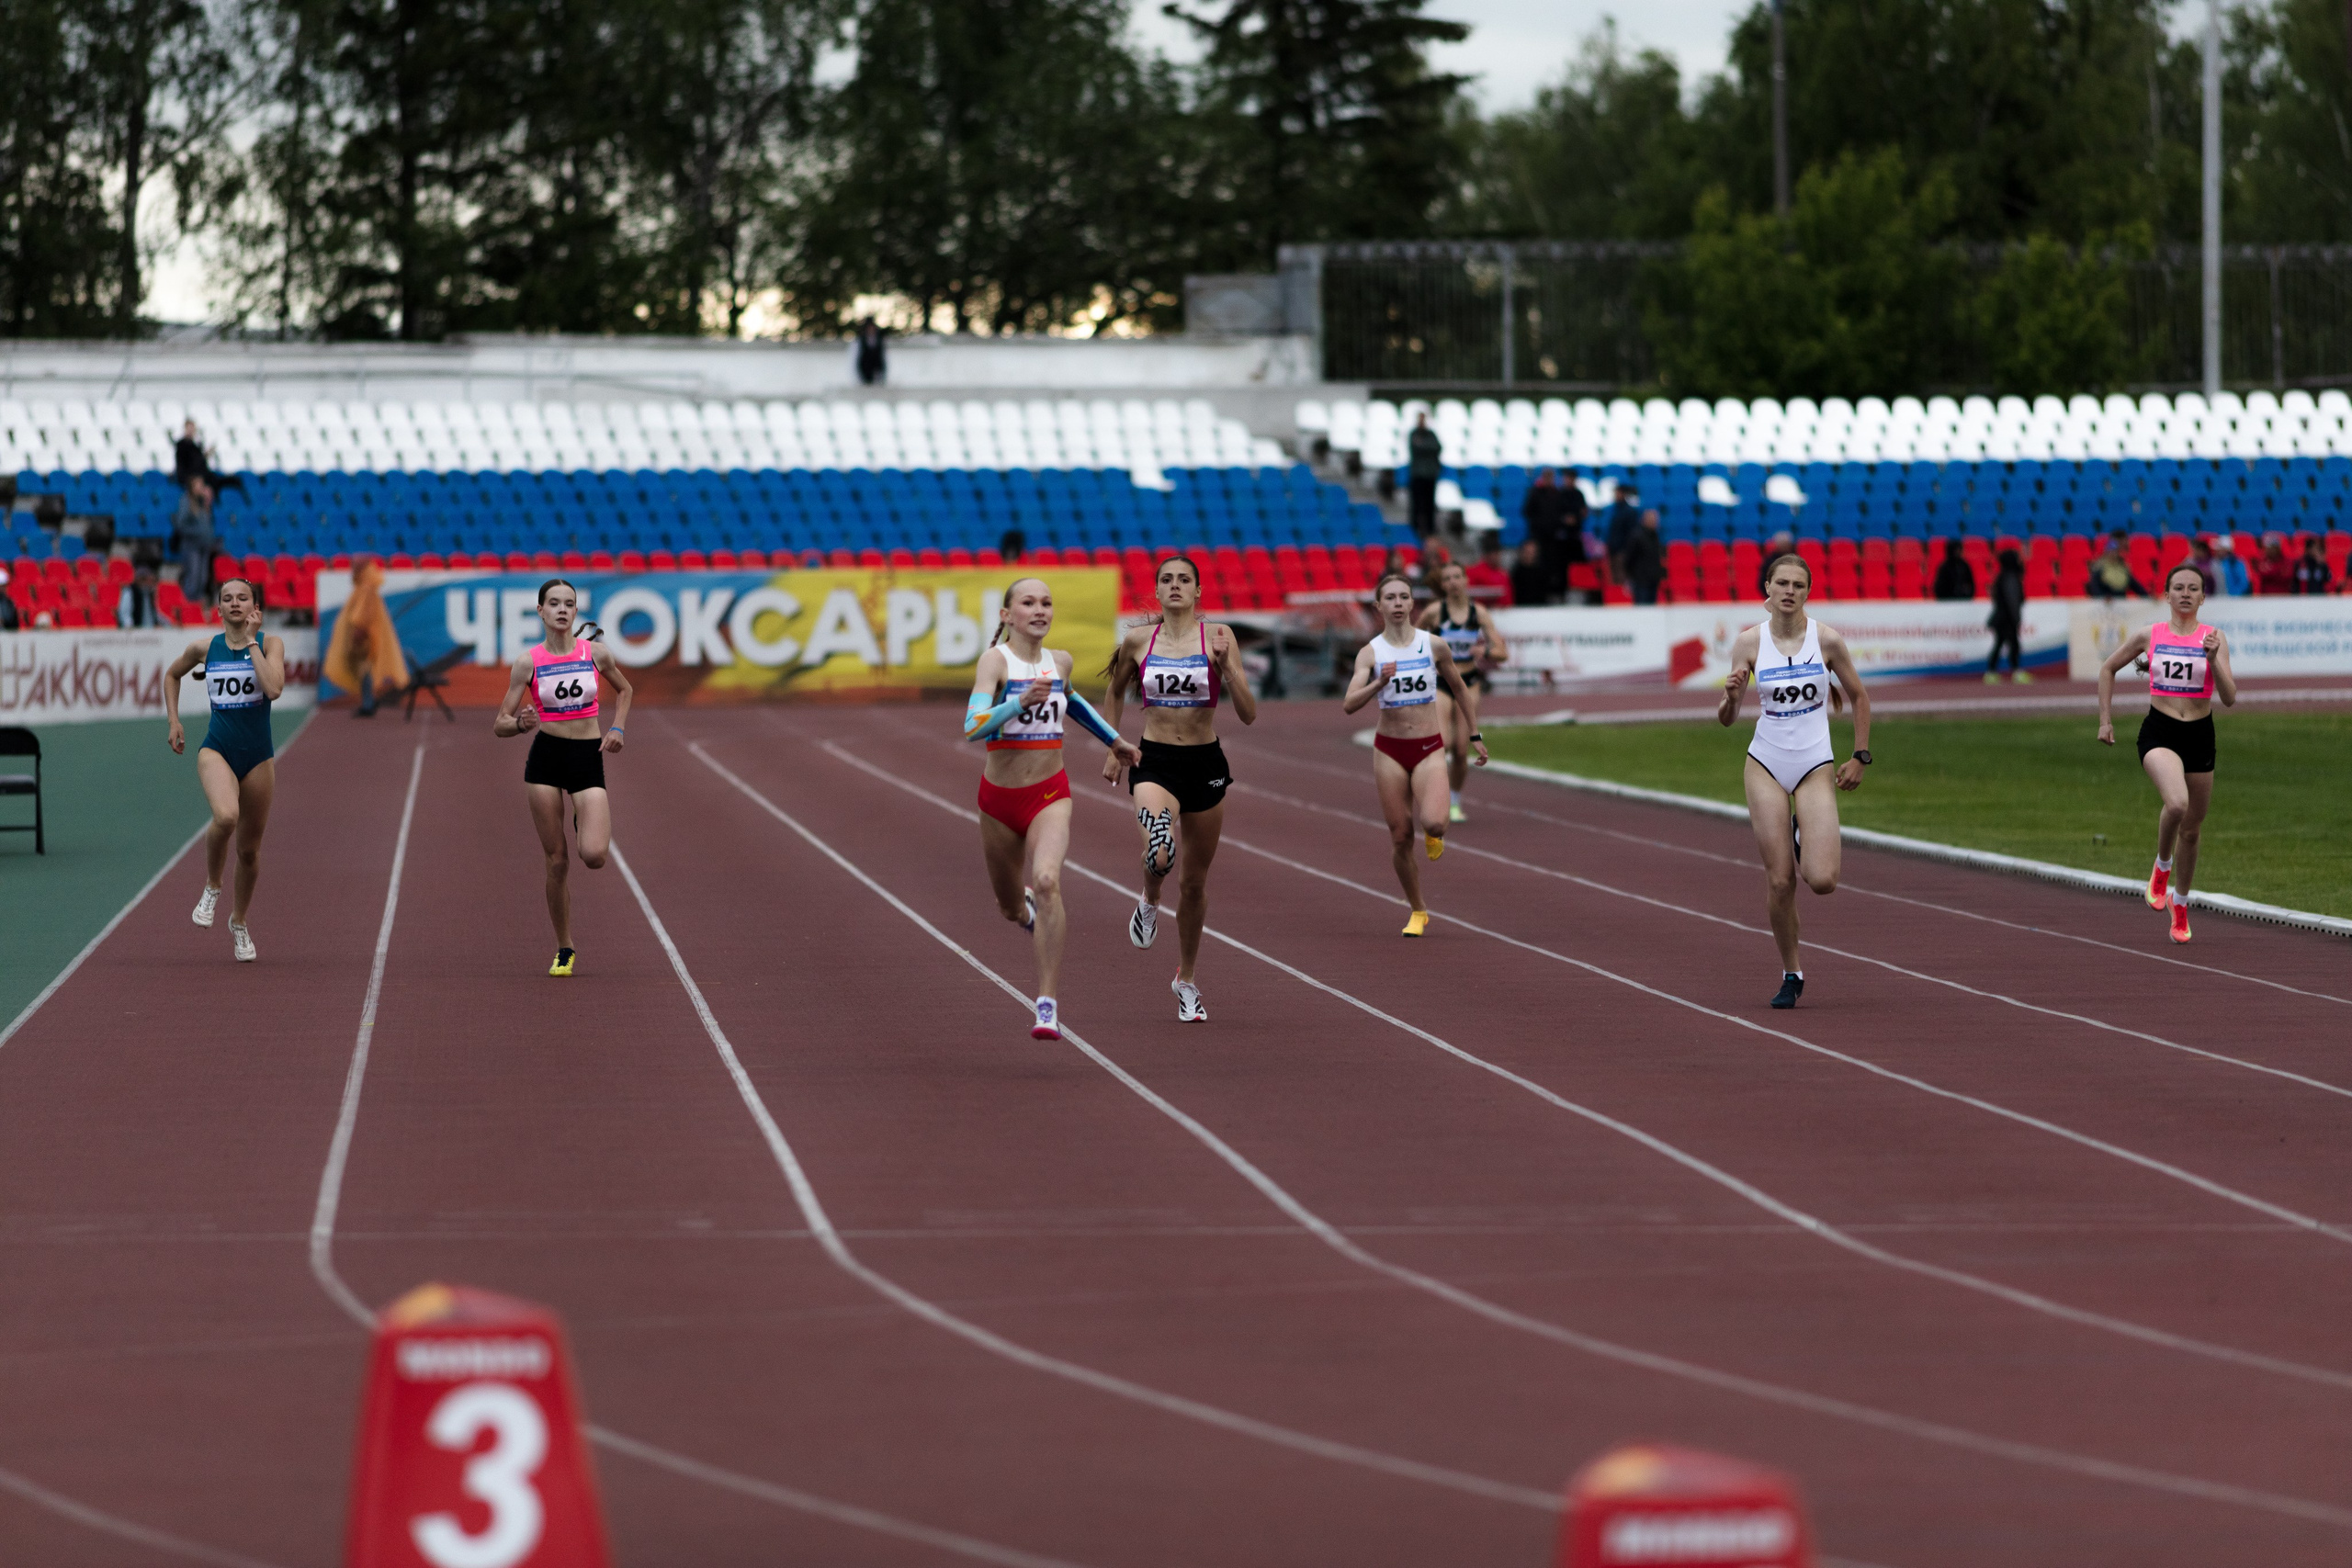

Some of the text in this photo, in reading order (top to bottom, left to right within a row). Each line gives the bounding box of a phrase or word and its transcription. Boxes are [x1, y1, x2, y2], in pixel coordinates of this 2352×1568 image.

[2162, 660, 2193, 681] 121
[213, 676, 255, 696] 706
[554, 678, 583, 700] 66
[1155, 673, 1198, 694] 124
[1391, 674, 1428, 694] 136
[1772, 682, 1818, 704] 490
[410, 1381, 549, 1568] 3
